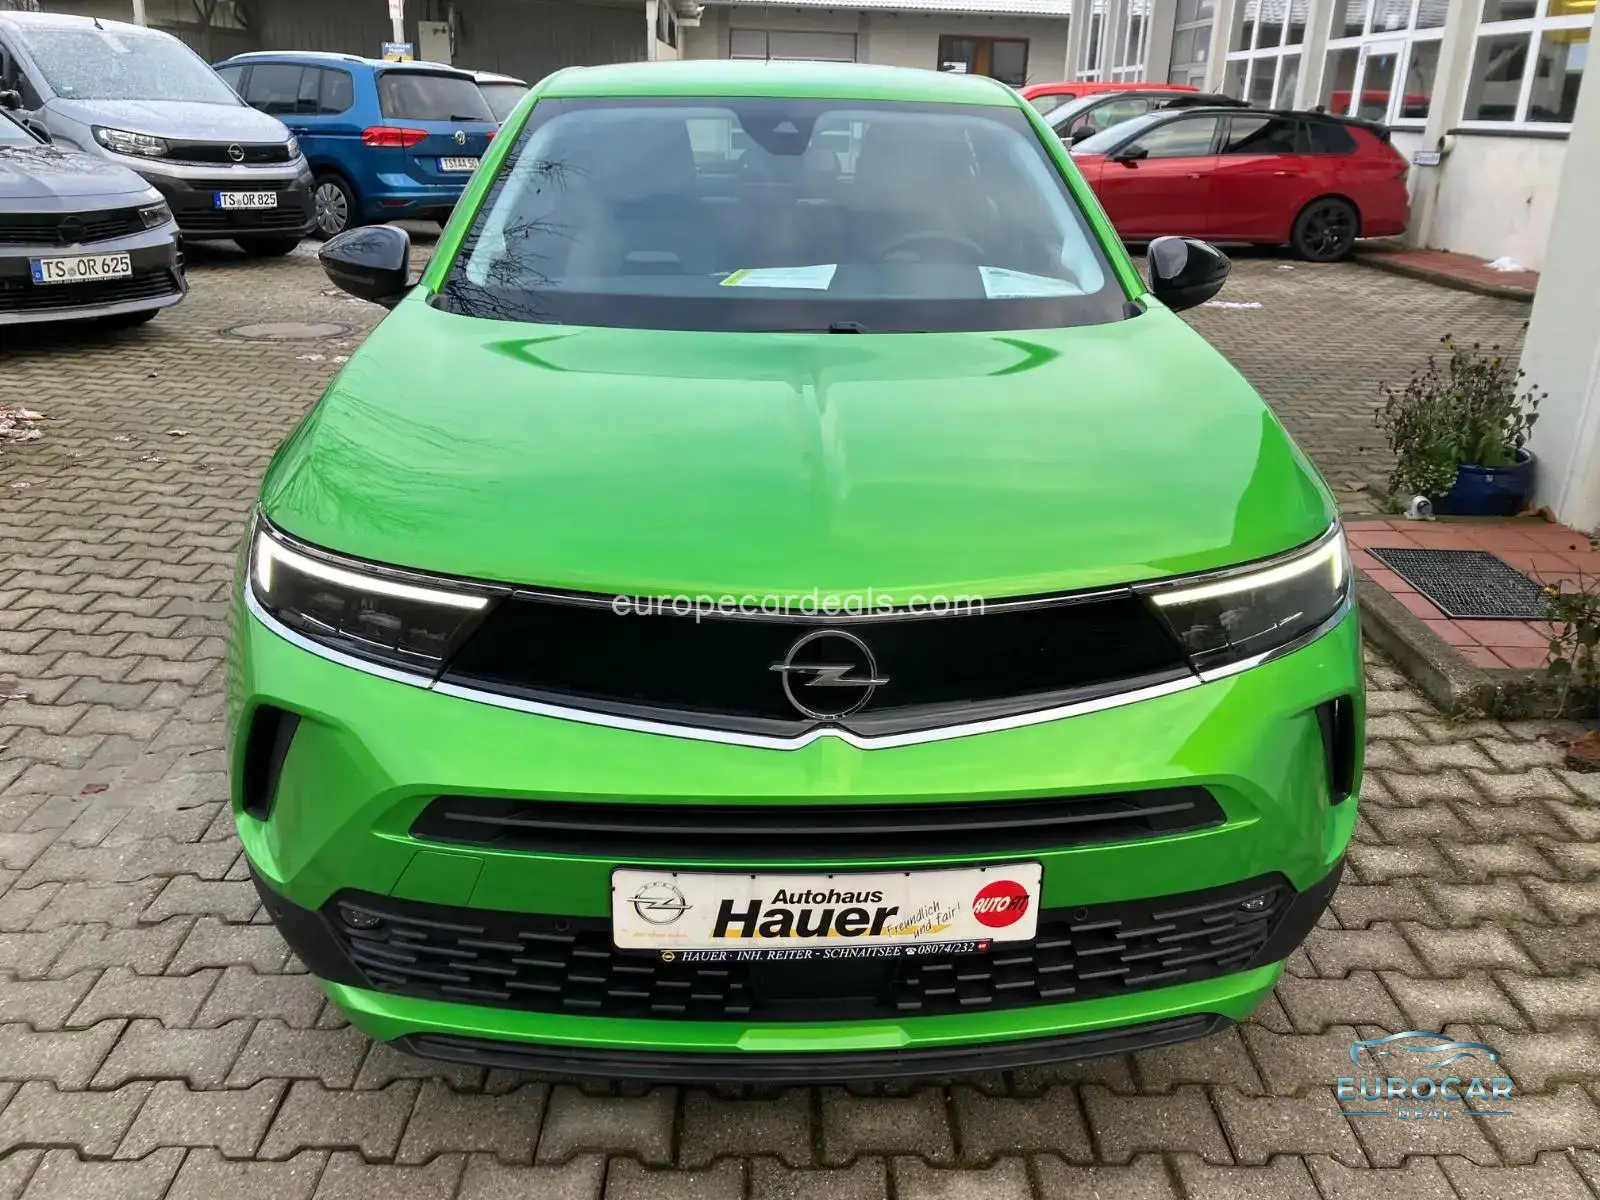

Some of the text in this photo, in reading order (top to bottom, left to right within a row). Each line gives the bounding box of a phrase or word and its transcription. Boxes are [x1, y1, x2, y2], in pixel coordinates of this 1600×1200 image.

[221, 194, 276, 206] TS OR 825
[43, 256, 130, 278] TS OR 625
[771, 888, 884, 905] Autohaus
[712, 899, 900, 938] Hauer
[886, 900, 941, 938] Freundlich
[913, 901, 961, 939] und fair!
[682, 951, 727, 962] HAUER
[736, 950, 763, 961] INH.
[767, 949, 813, 960] REITER
[823, 946, 901, 959] SCHNAITSEE
[917, 942, 976, 955] 08074/232
